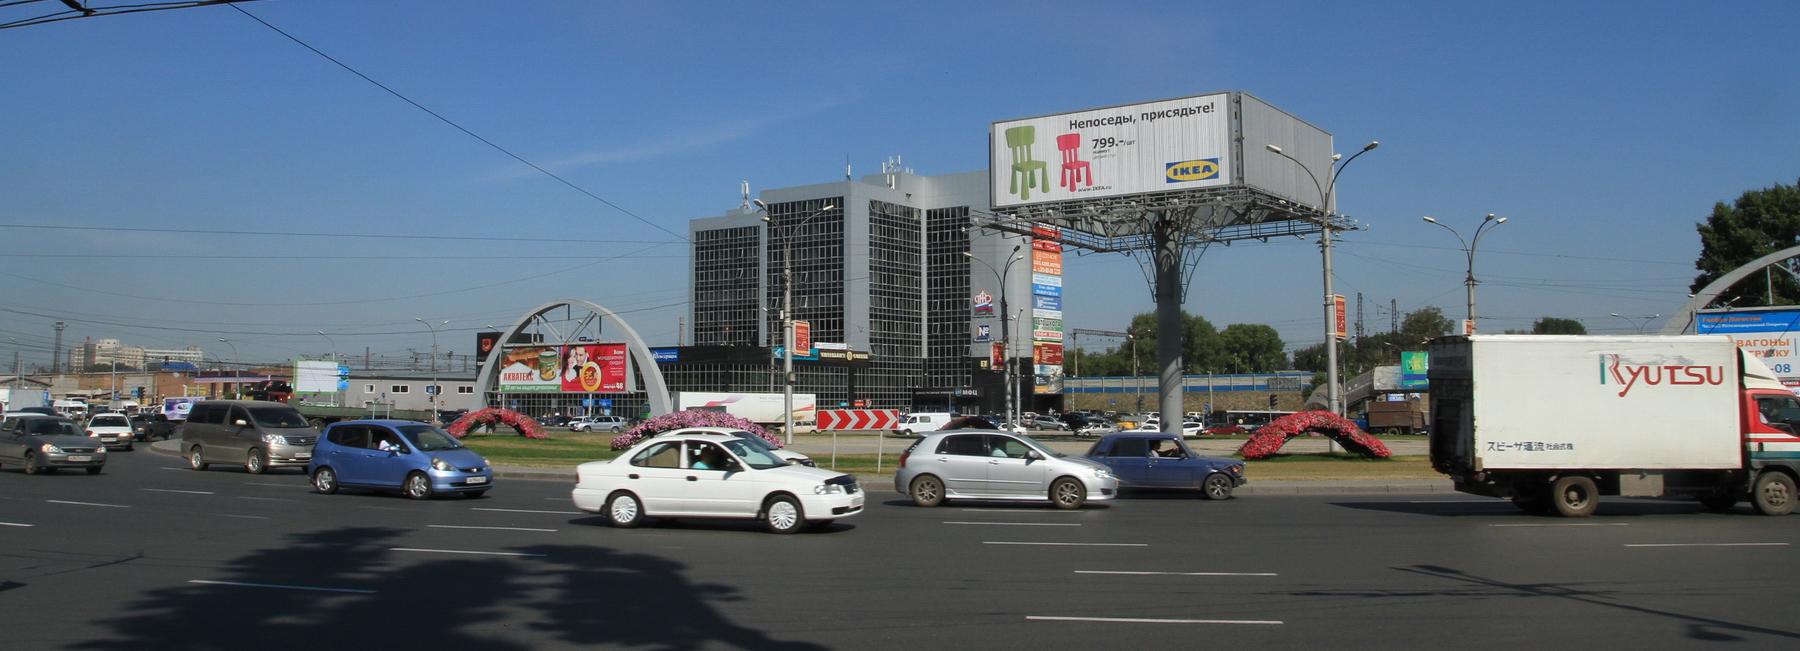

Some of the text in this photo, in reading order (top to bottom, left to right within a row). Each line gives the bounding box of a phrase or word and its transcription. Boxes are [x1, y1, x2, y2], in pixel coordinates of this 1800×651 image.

[1070, 102, 1215, 130] Непоседы, присядьте!
[1172, 164, 1213, 177] IKEA
[1736, 339, 1790, 347] ВАГОНЫ
